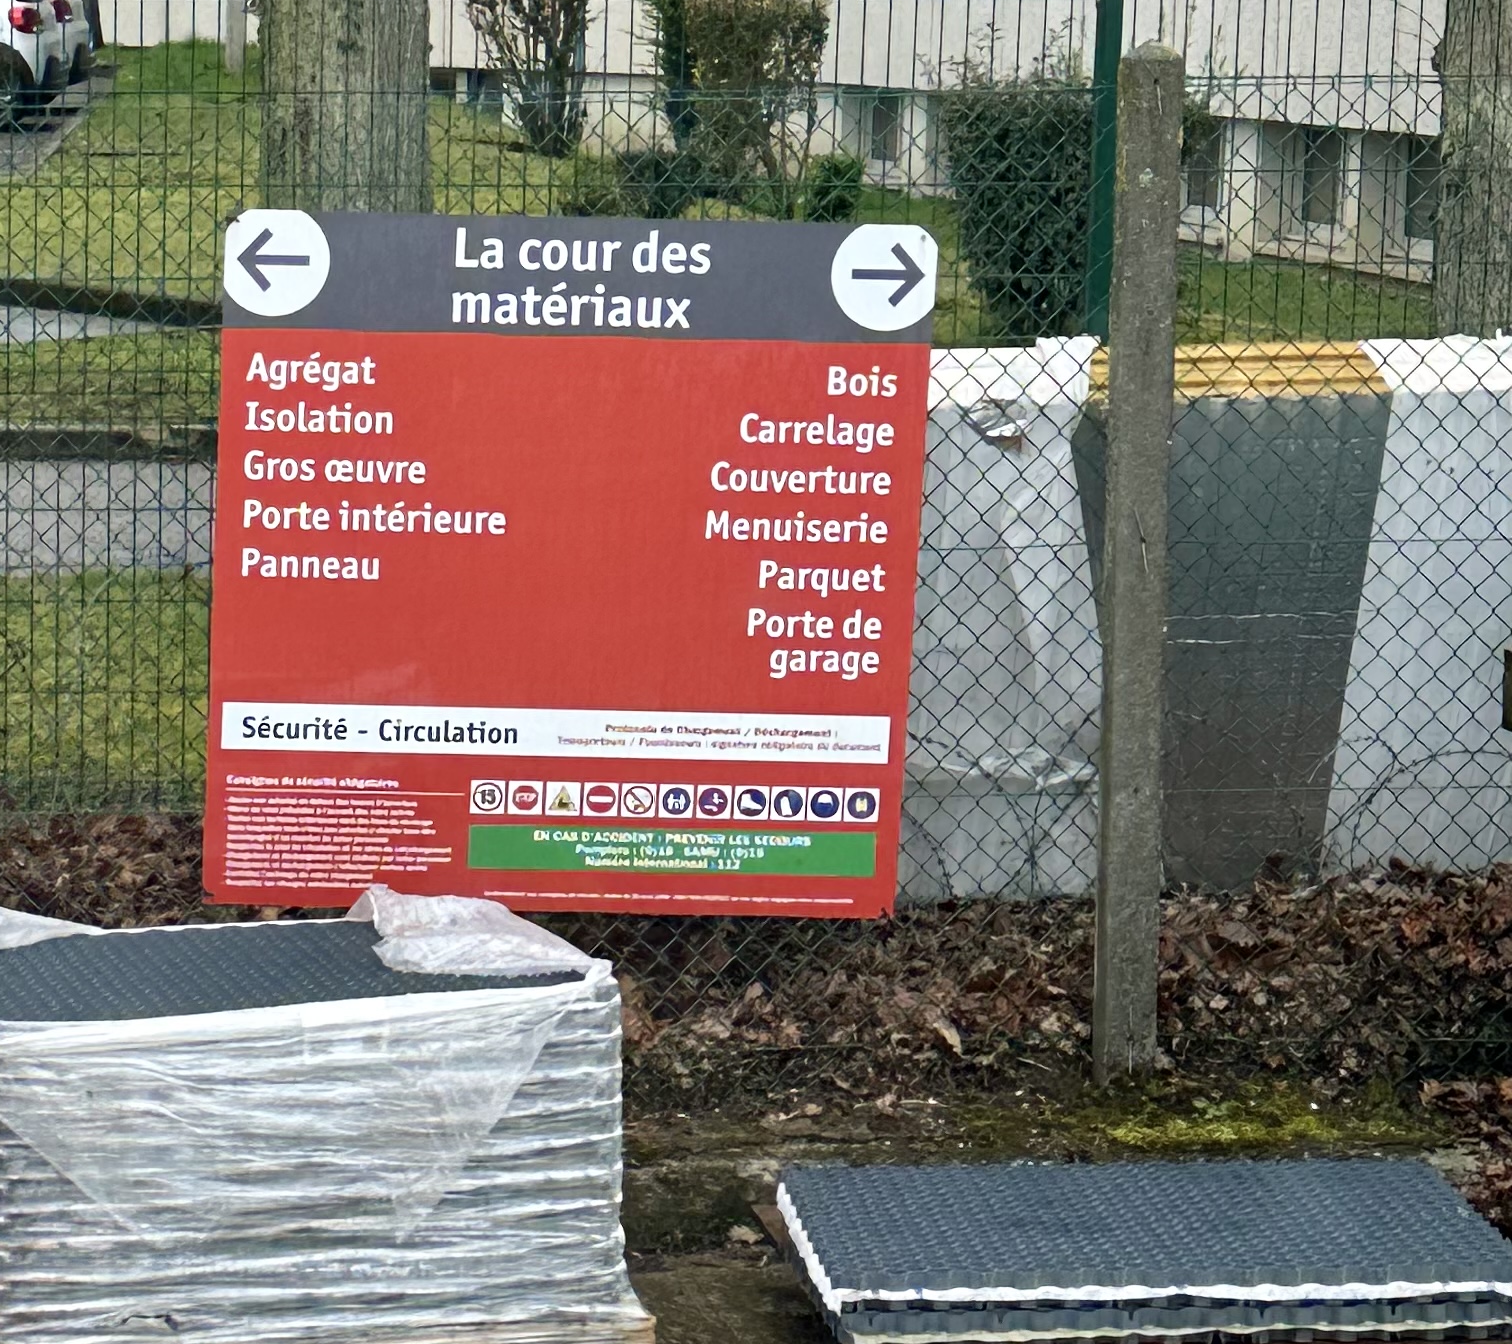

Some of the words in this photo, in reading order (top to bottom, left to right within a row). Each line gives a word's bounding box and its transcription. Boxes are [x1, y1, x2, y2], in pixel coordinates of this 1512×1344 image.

[456, 228, 503, 269] La
[519, 237, 620, 272] cour
[633, 230, 710, 274] des
[453, 282, 690, 328] matériaux
[247, 352, 375, 391] Agrégat
[828, 366, 897, 397] Bois
[245, 402, 392, 434] Isolation
[740, 413, 894, 450] Carrelage
[244, 450, 315, 481] Gros
[325, 460, 425, 483] œuvre
[711, 461, 891, 495] Couverture
[244, 500, 329, 530] Porte
[339, 501, 506, 534] intérieure
[705, 510, 887, 543] Menuiserie
[242, 548, 379, 579] Panneau
[759, 560, 885, 597] Parquet
[748, 608, 833, 638] Porte
[843, 609, 881, 639] de
[770, 650, 879, 680] garage
[243, 716, 347, 740] Sécurité
[379, 719, 517, 743] Circulation
